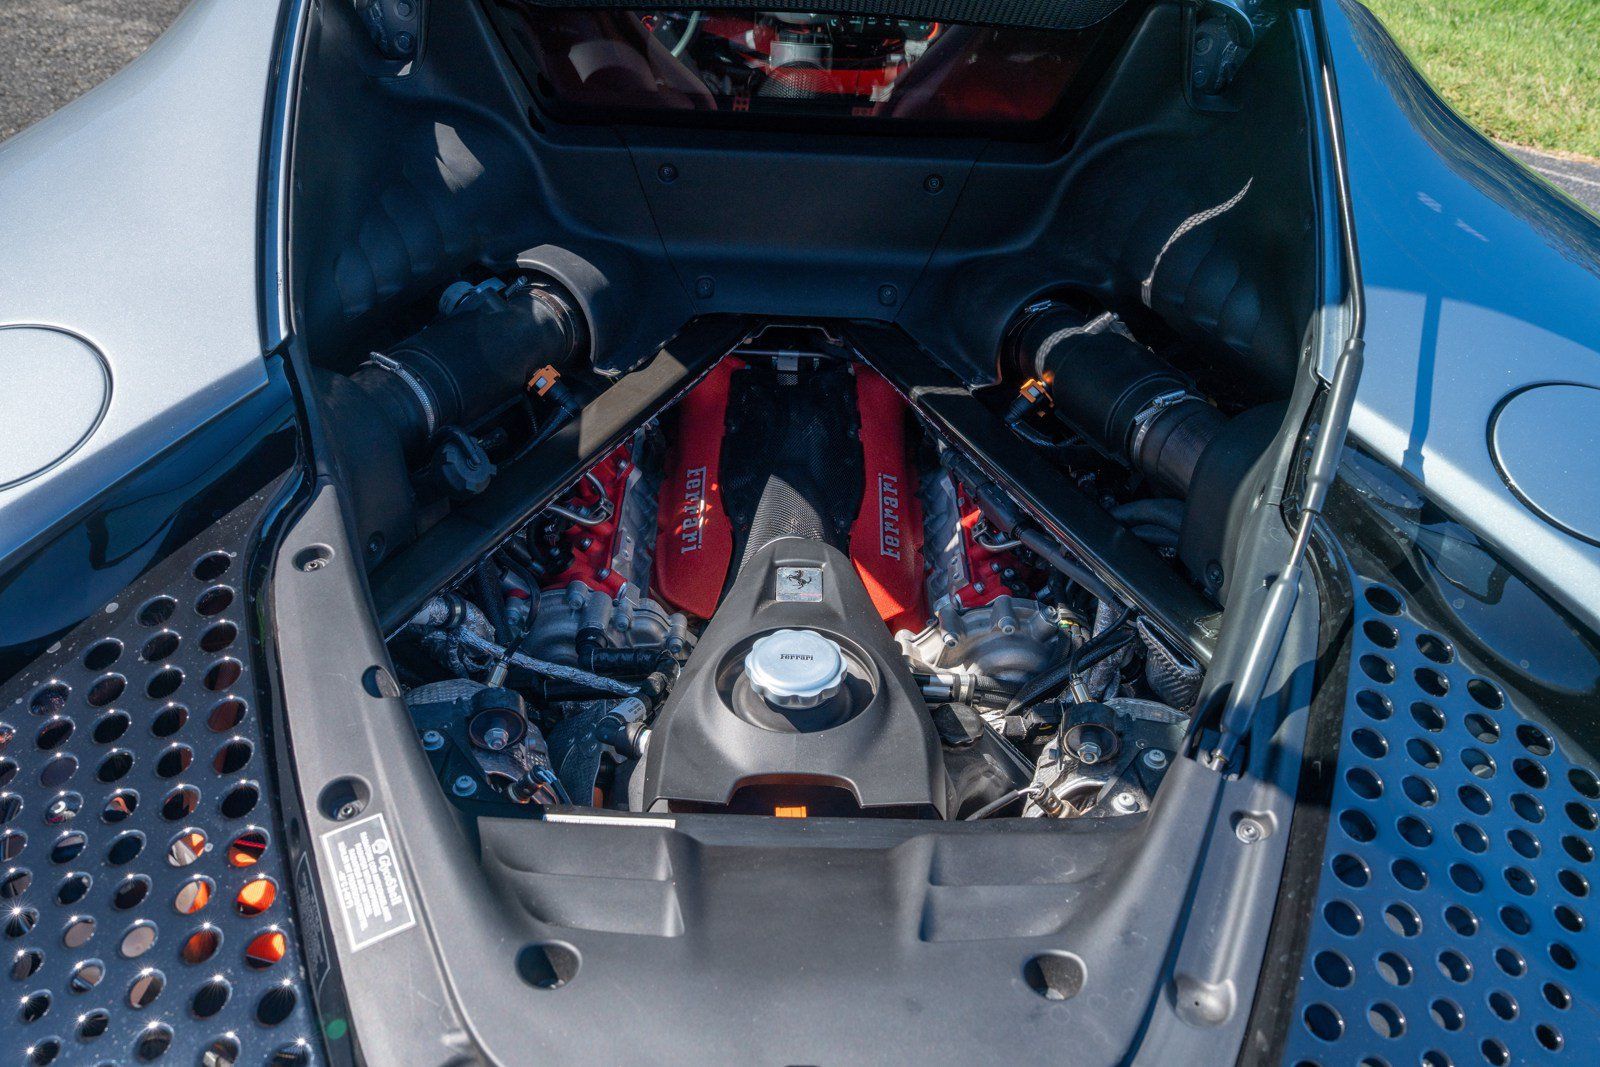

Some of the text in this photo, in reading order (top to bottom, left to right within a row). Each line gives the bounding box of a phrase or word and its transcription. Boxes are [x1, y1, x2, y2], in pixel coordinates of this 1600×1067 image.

[681, 466, 706, 553] Ferrari
[878, 473, 901, 560] Ferrari
[780, 653, 814, 661] Ferrari
